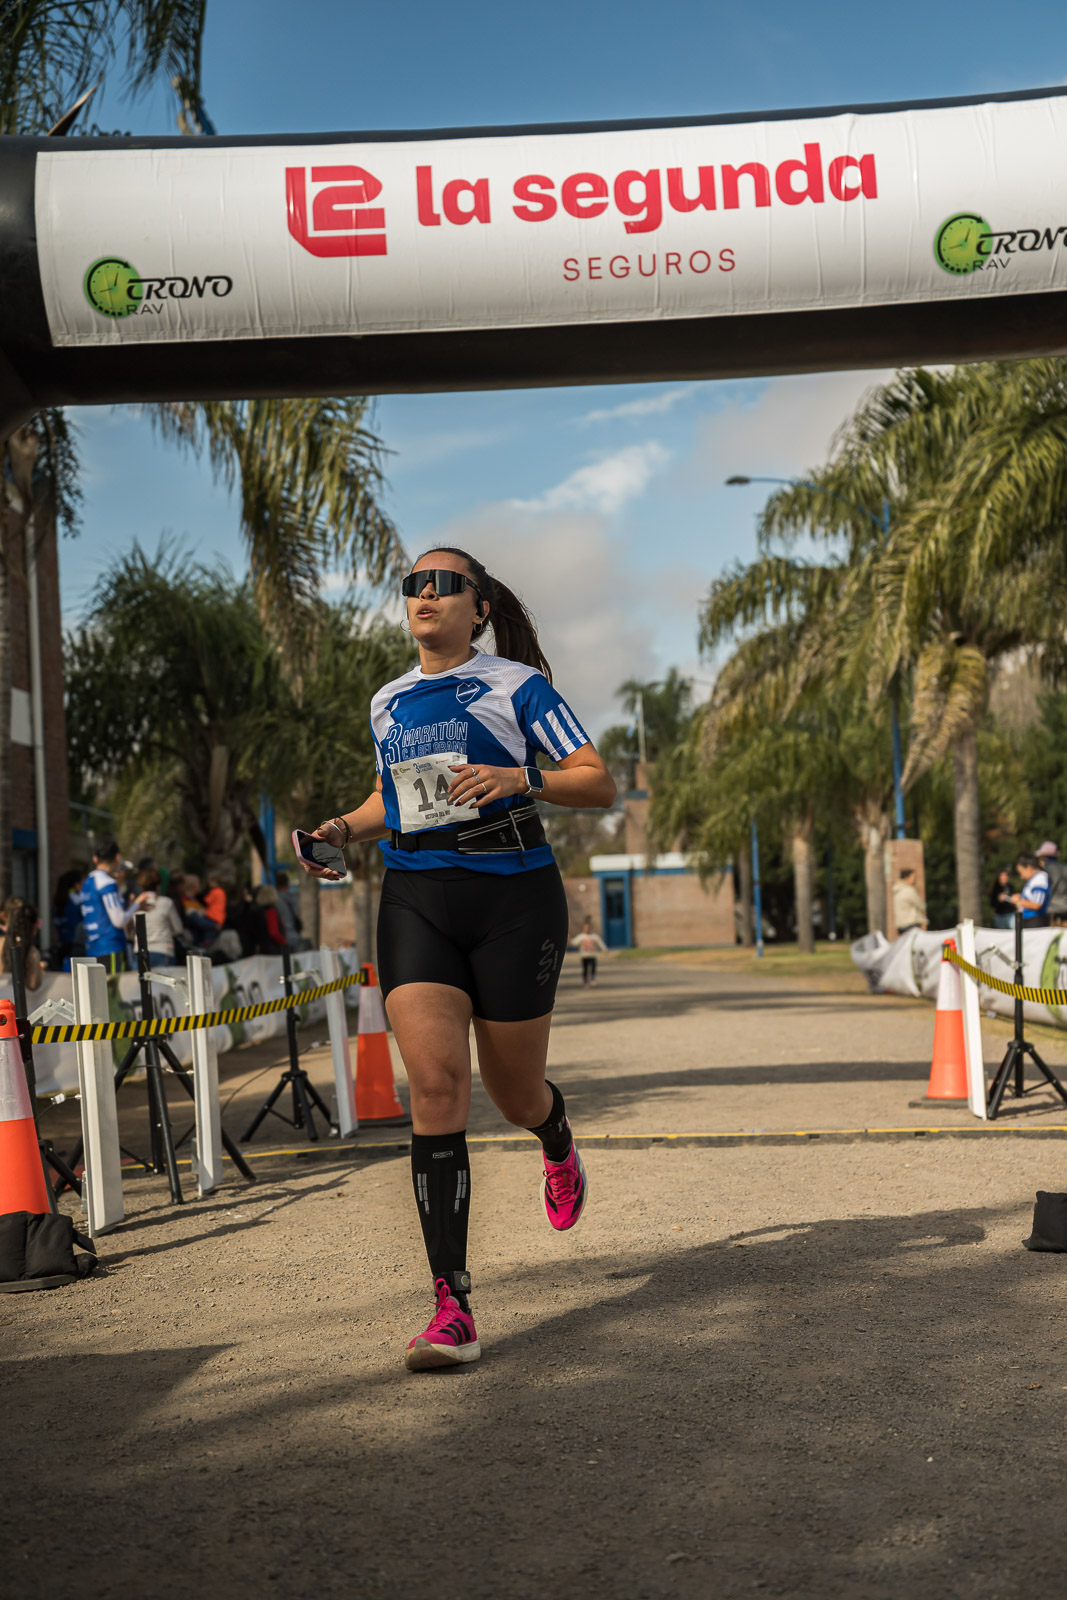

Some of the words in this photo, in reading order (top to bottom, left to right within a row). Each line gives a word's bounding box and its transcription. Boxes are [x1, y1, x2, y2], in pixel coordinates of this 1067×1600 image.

[415, 165, 491, 226] la
[512, 142, 878, 234] segunda
[563, 248, 736, 281] SEGUROS
[972, 257, 1011, 272] RAV
[126, 275, 233, 300] CRONO
[126, 303, 164, 315] RAV
[402, 718, 468, 748] MARATÓN
[413, 774, 454, 812] 14
